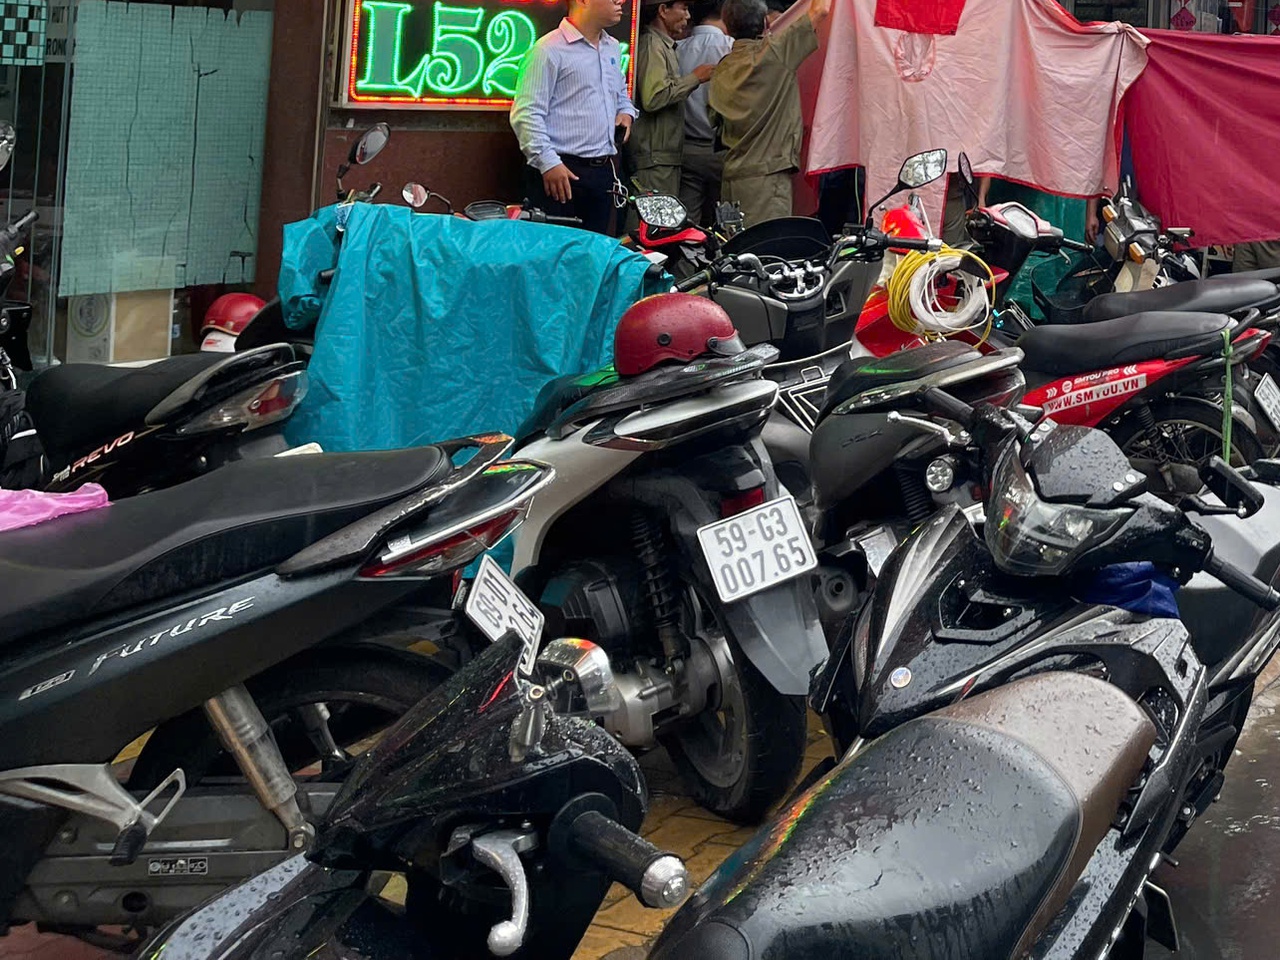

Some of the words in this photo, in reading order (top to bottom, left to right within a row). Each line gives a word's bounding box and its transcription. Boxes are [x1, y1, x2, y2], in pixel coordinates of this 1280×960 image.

[1102, 368, 1119, 377] PRO
[71, 431, 135, 473] REVO
[713, 507, 788, 558] 59-G3
[720, 536, 807, 594] 007.65
[476, 568, 511, 629] 69-D1
[88, 595, 256, 677] FUTURE
